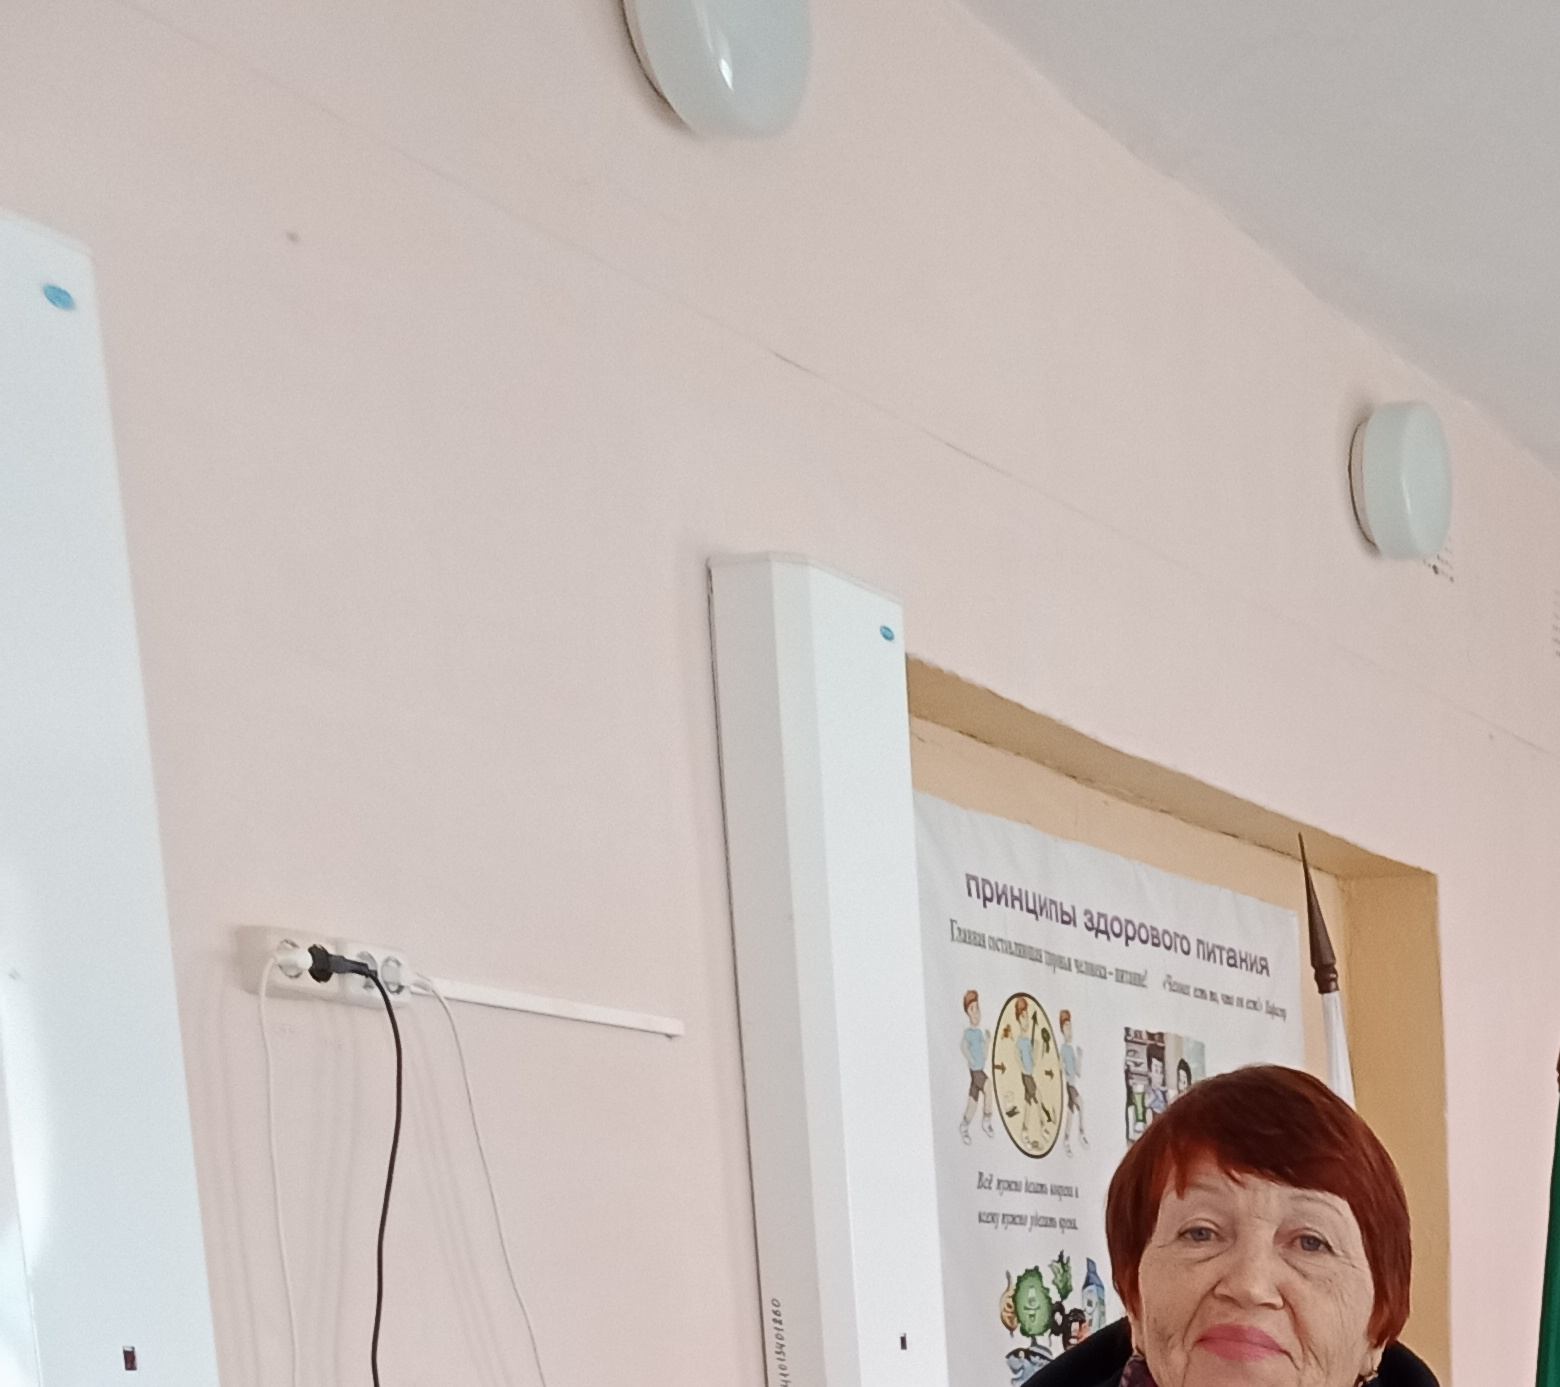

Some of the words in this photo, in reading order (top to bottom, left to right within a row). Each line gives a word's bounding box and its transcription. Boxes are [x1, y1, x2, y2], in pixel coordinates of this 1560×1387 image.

[965, 873, 1077, 928] принципы
[1083, 908, 1191, 957] здорового
[1196, 938, 1271, 978] питания
